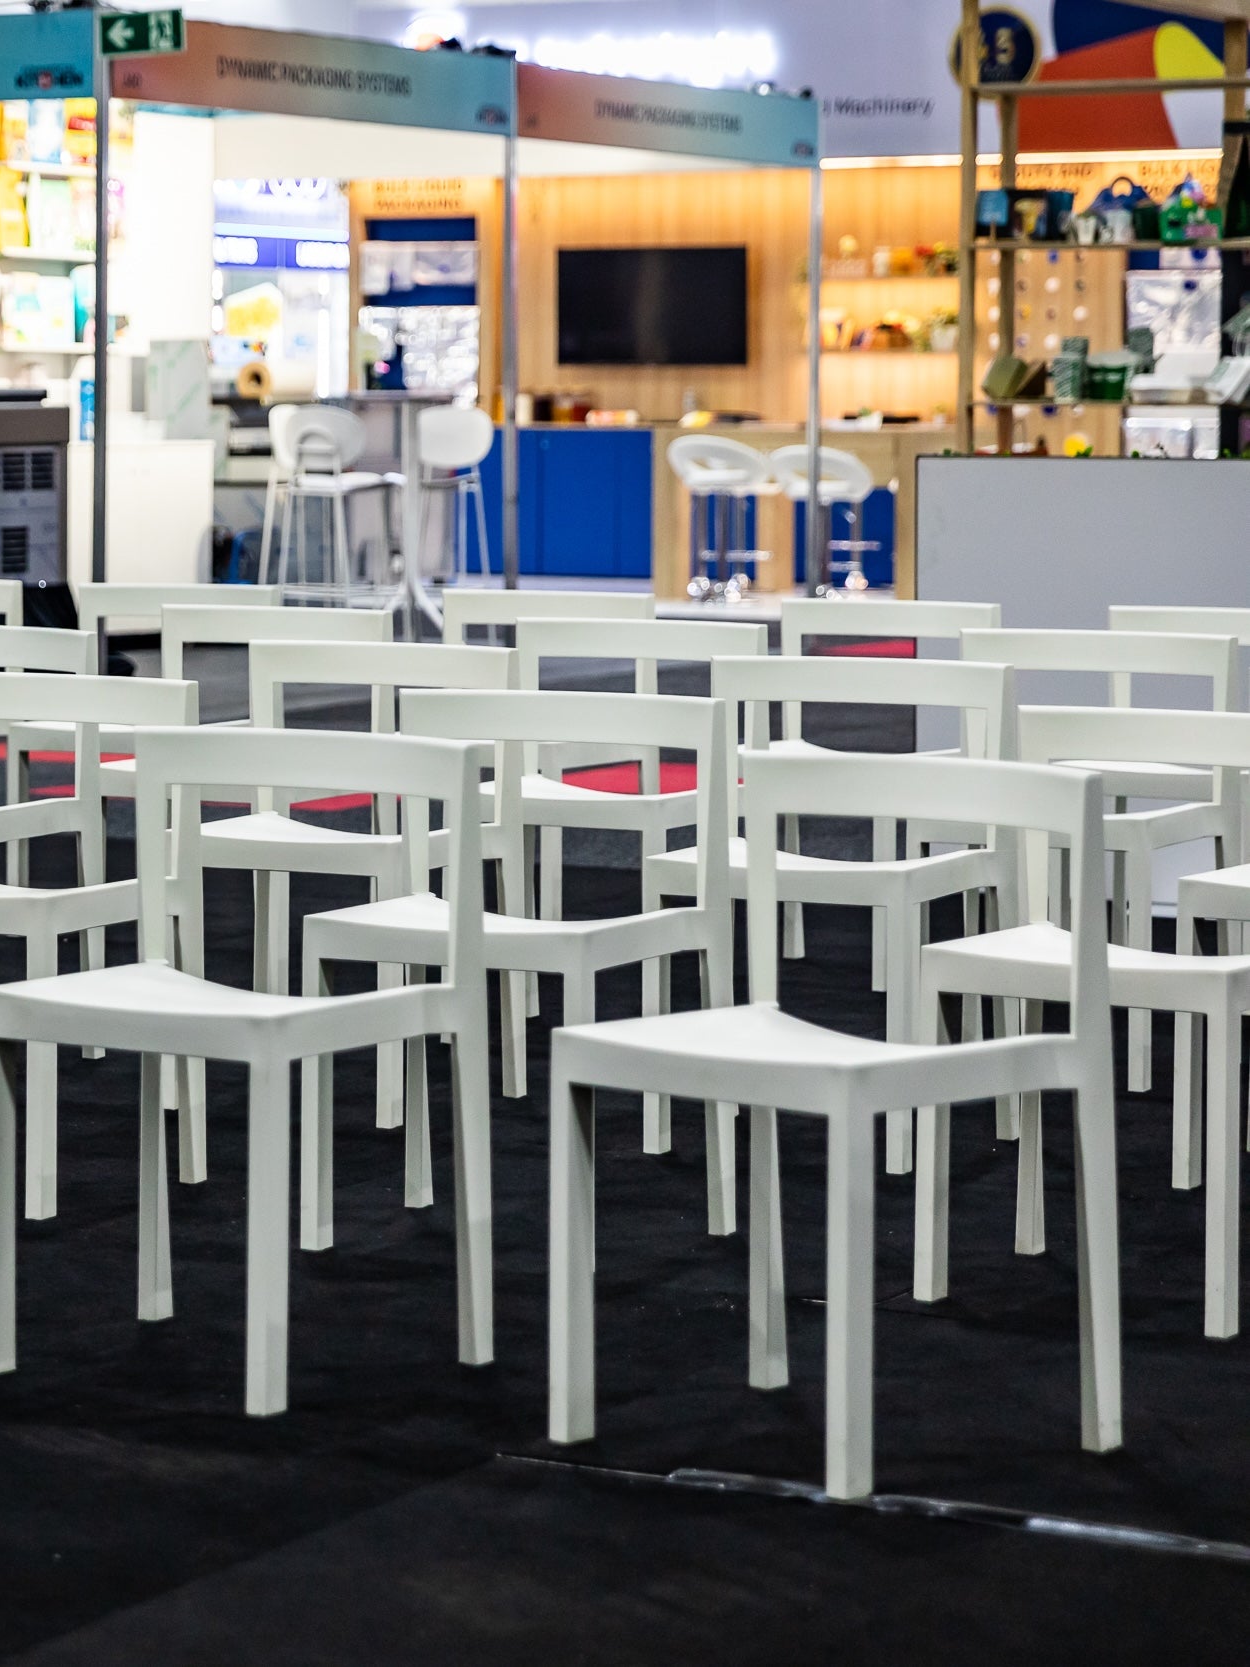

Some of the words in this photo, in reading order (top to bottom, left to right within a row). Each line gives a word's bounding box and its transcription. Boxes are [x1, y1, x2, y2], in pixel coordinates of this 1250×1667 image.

[217, 55, 277, 82] DYNAMIC
[356, 69, 412, 97] SYSTEMS
[834, 97, 935, 117] Machinery
